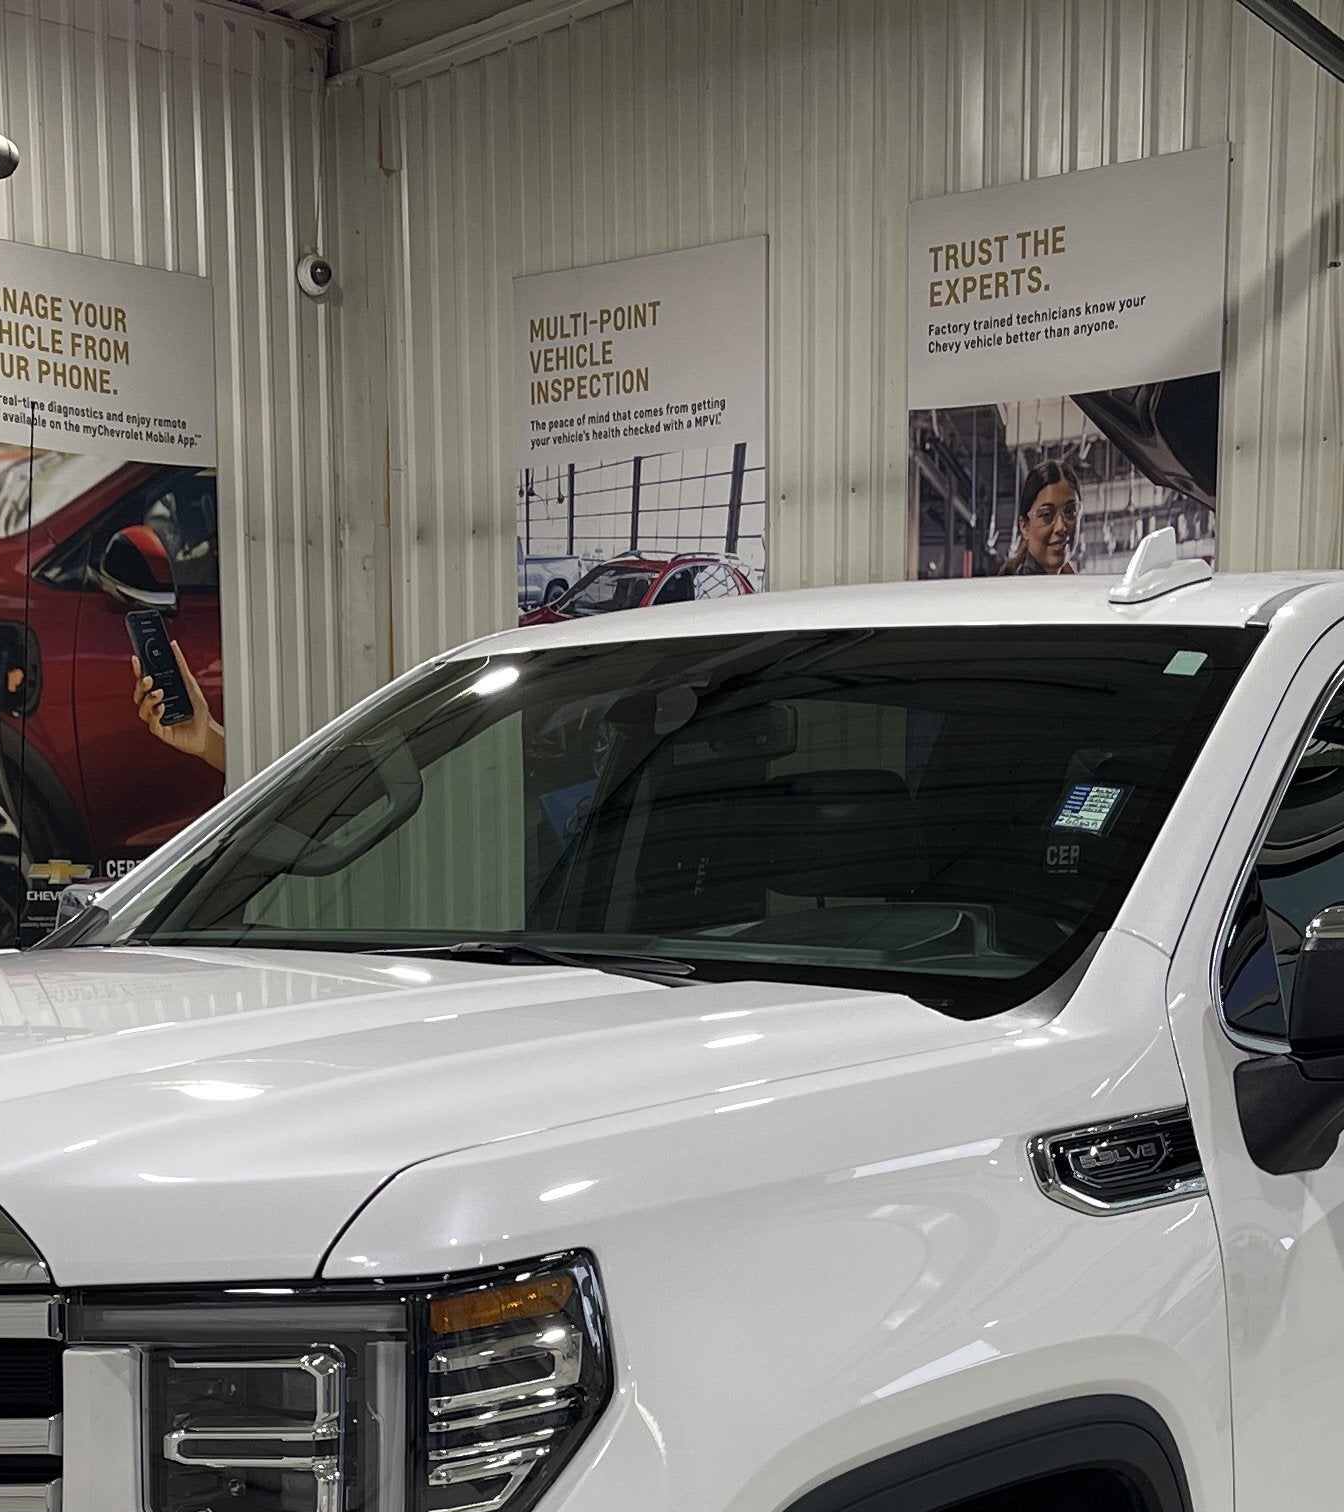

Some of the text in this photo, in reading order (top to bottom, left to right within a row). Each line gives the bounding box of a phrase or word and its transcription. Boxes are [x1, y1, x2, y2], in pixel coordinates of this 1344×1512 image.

[928, 225, 1066, 273] TRUST THE
[929, 266, 1050, 307] EXPERTS.
[69, 299, 127, 333] YOUR
[530, 301, 661, 343] MULTI-POINT
[928, 295, 1146, 336] Factory trained technicians know your
[71, 332, 130, 366] FROM
[928, 318, 1119, 354] Chevy vehicle better than anyone.
[530, 340, 613, 374] VEHICLE
[38, 359, 118, 396] PHONE.
[530, 367, 649, 406] INSPECTION
[48, 401, 103, 421] diagnostics
[106, 410, 124, 423] and
[126, 414, 151, 430] enjoy
[153, 418, 187, 430] remote
[49, 421, 62, 430] on
[64, 420, 80, 433] the
[83, 424, 143, 442] myChevrolet
[145, 431, 175, 445] Mobile
[530, 398, 726, 432] The peace of mind that comes from getting
[530, 436, 550, 450] your
[552, 430, 590, 445] vehicle's
[592, 427, 621, 441] health
[623, 421, 660, 438] checked
[663, 417, 685, 431] with
[686, 420, 692, 429] a
